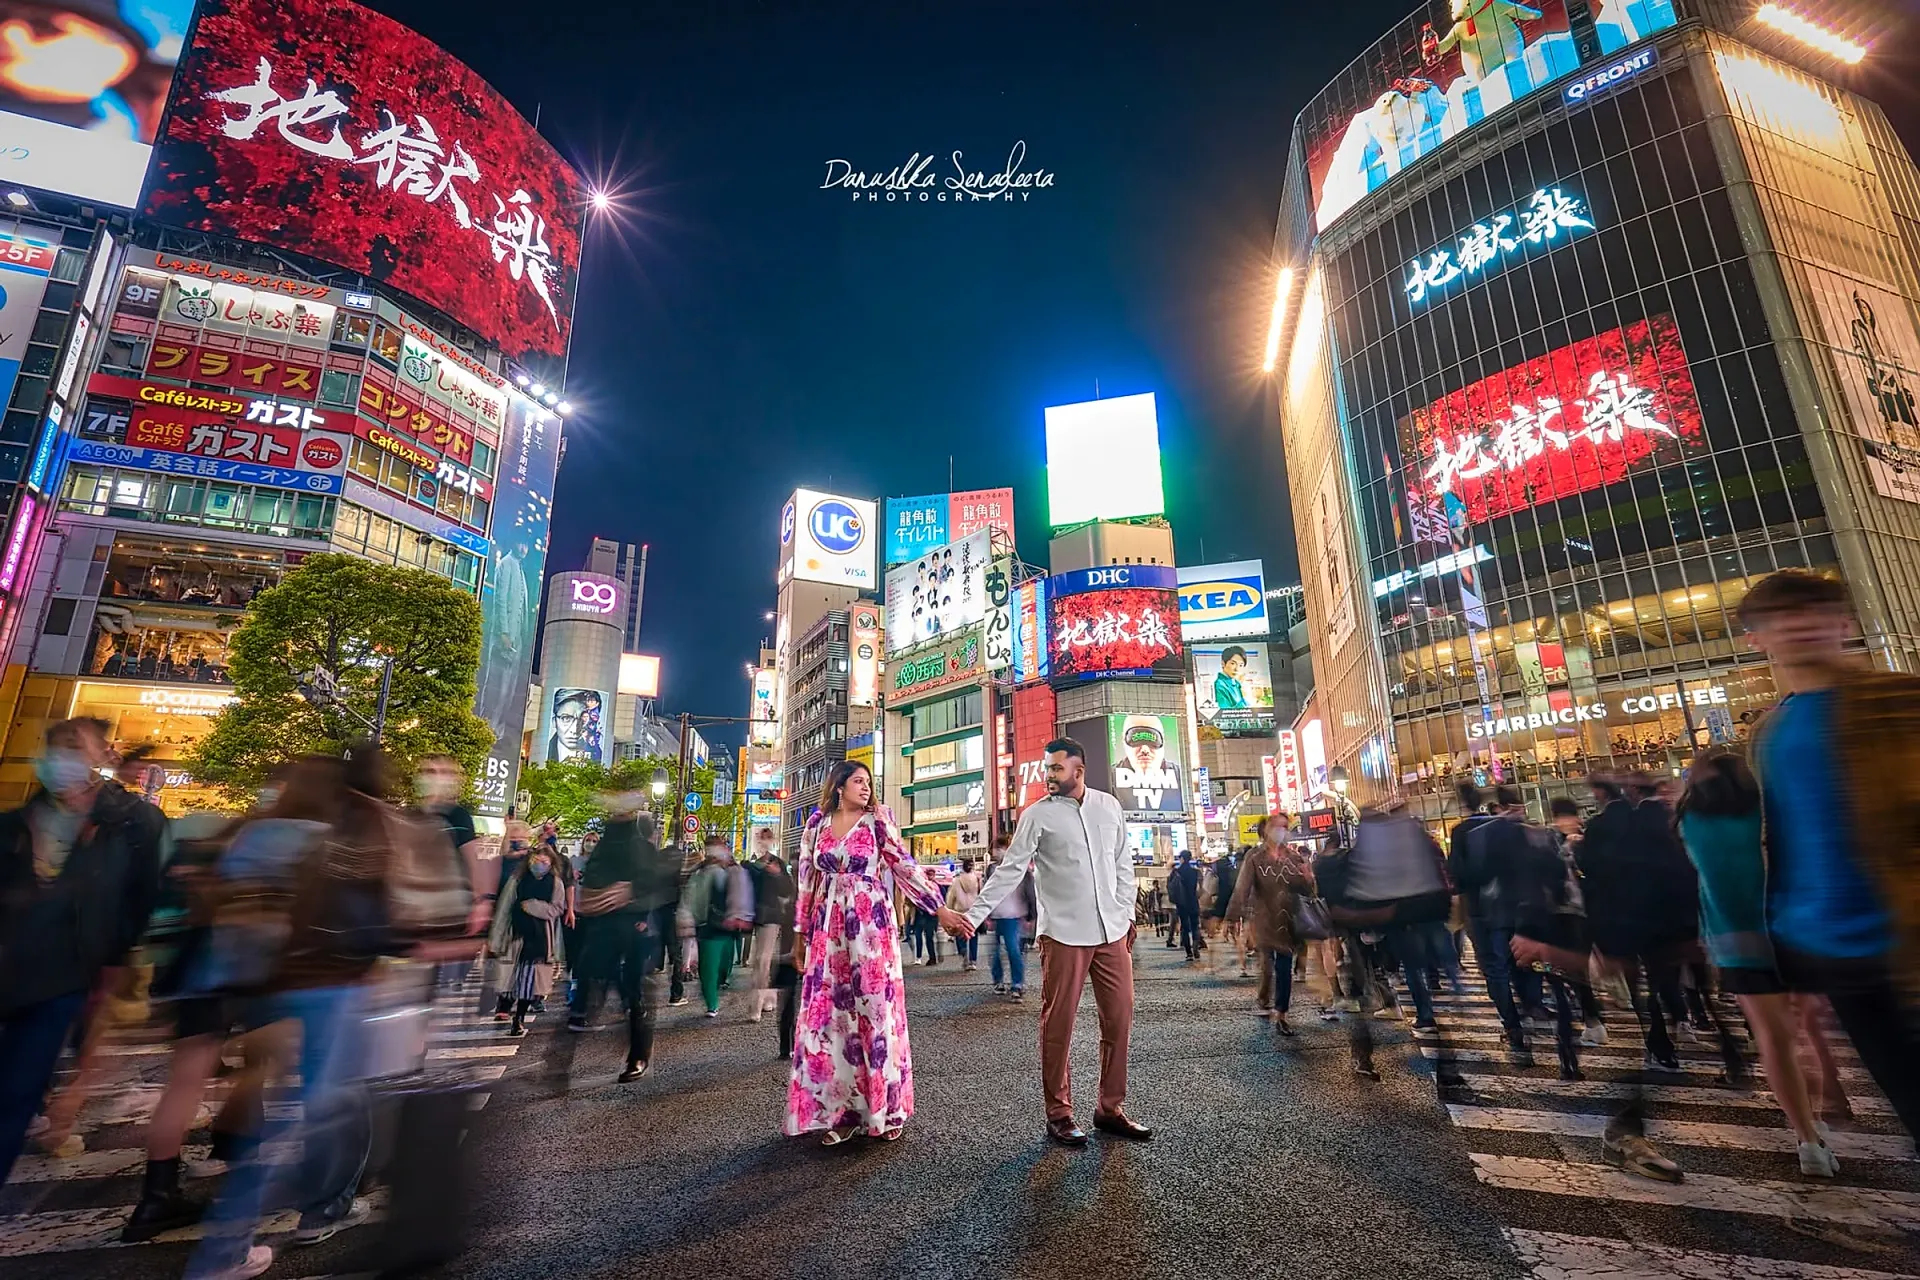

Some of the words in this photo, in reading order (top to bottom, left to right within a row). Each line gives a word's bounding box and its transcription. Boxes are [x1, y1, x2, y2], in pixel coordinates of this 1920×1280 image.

[1567, 52, 1650, 98] QFRONT
[200, 55, 560, 334] 地獄楽
[1403, 187, 1597, 302] 地獄楽
[155, 253, 332, 298] しゃぶしゃぶバイキング
[126, 285, 161, 303] 9F
[224, 299, 322, 336] しゃぶ葉
[399, 312, 507, 389] しゃぶしゃぶバイキング
[154, 345, 317, 392] プライス
[437, 369, 500, 420] しゃぶ葉
[86, 411, 129, 434] 7F
[137, 418, 185, 438] Café
[245, 399, 326, 430] ガスト
[360, 382, 469, 454] コンタクト
[136, 433, 182, 448] レストラン
[185, 424, 289, 464] ガスト
[1424, 369, 1680, 494] 地獄楽
[79, 444, 134, 464] AEON
[307, 450, 339, 461] ガスト
[150, 451, 300, 486] 英会話イーオン
[309, 475, 331, 490] 6F
[435, 460, 485, 497] ガスト
[815, 510, 859, 542] UC
[899, 507, 938, 527] 龍角散
[963, 502, 1002, 521] 龍角散
[844, 567, 867, 578] VISA
[1087, 568, 1130, 586] DHC
[571, 579, 616, 614] 109
[571, 602, 600, 613] SHIBUYA
[1178, 590, 1254, 611] KEA
[1265, 586, 1291, 600] PARCO
[985, 564, 1011, 664] もんじゃ
[1055, 607, 1176, 655] 地獄楽
[1471, 701, 1608, 738] STARBUCKS
[1621, 686, 1728, 714] COFFEE
[473, 777, 508, 797] ラジオ
[1115, 767, 1179, 790] DMM
[1133, 788, 1164, 810] TV
